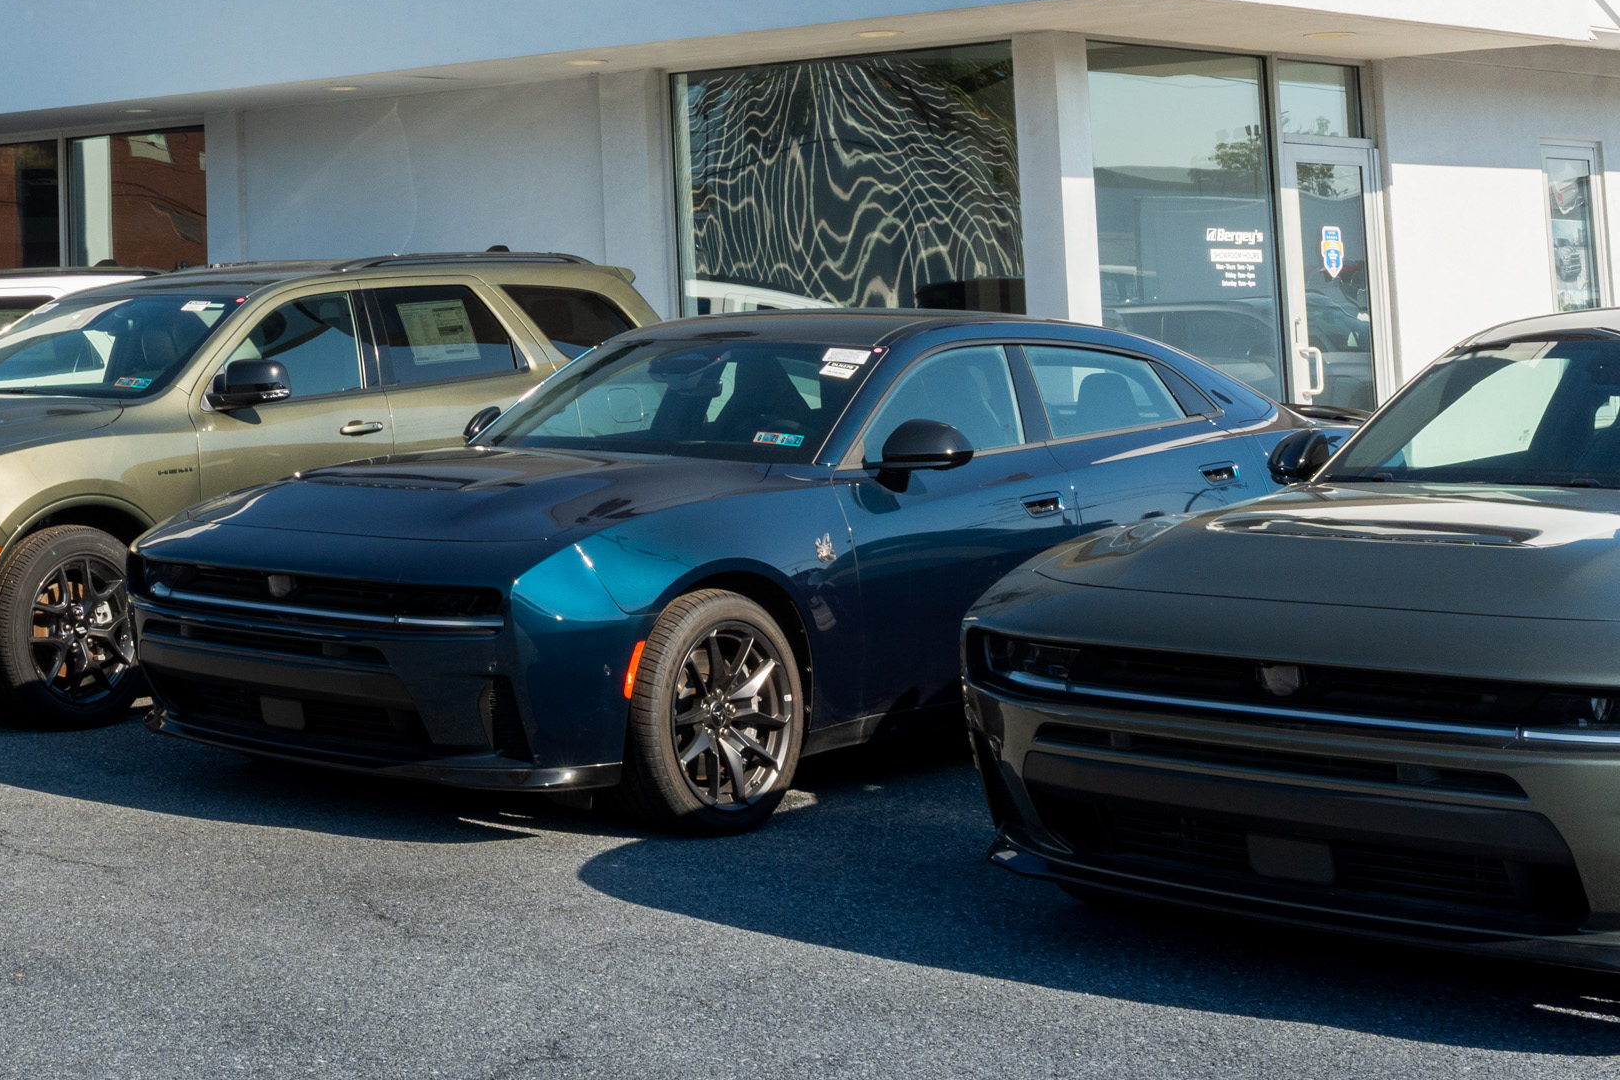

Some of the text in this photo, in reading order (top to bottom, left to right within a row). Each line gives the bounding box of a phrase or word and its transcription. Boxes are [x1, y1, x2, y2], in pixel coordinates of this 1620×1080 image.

[1216, 227, 1264, 245] Bergey's
[1213, 251, 1260, 260] SHOWROOM HOURS
[157, 466, 193, 476] HEMI
